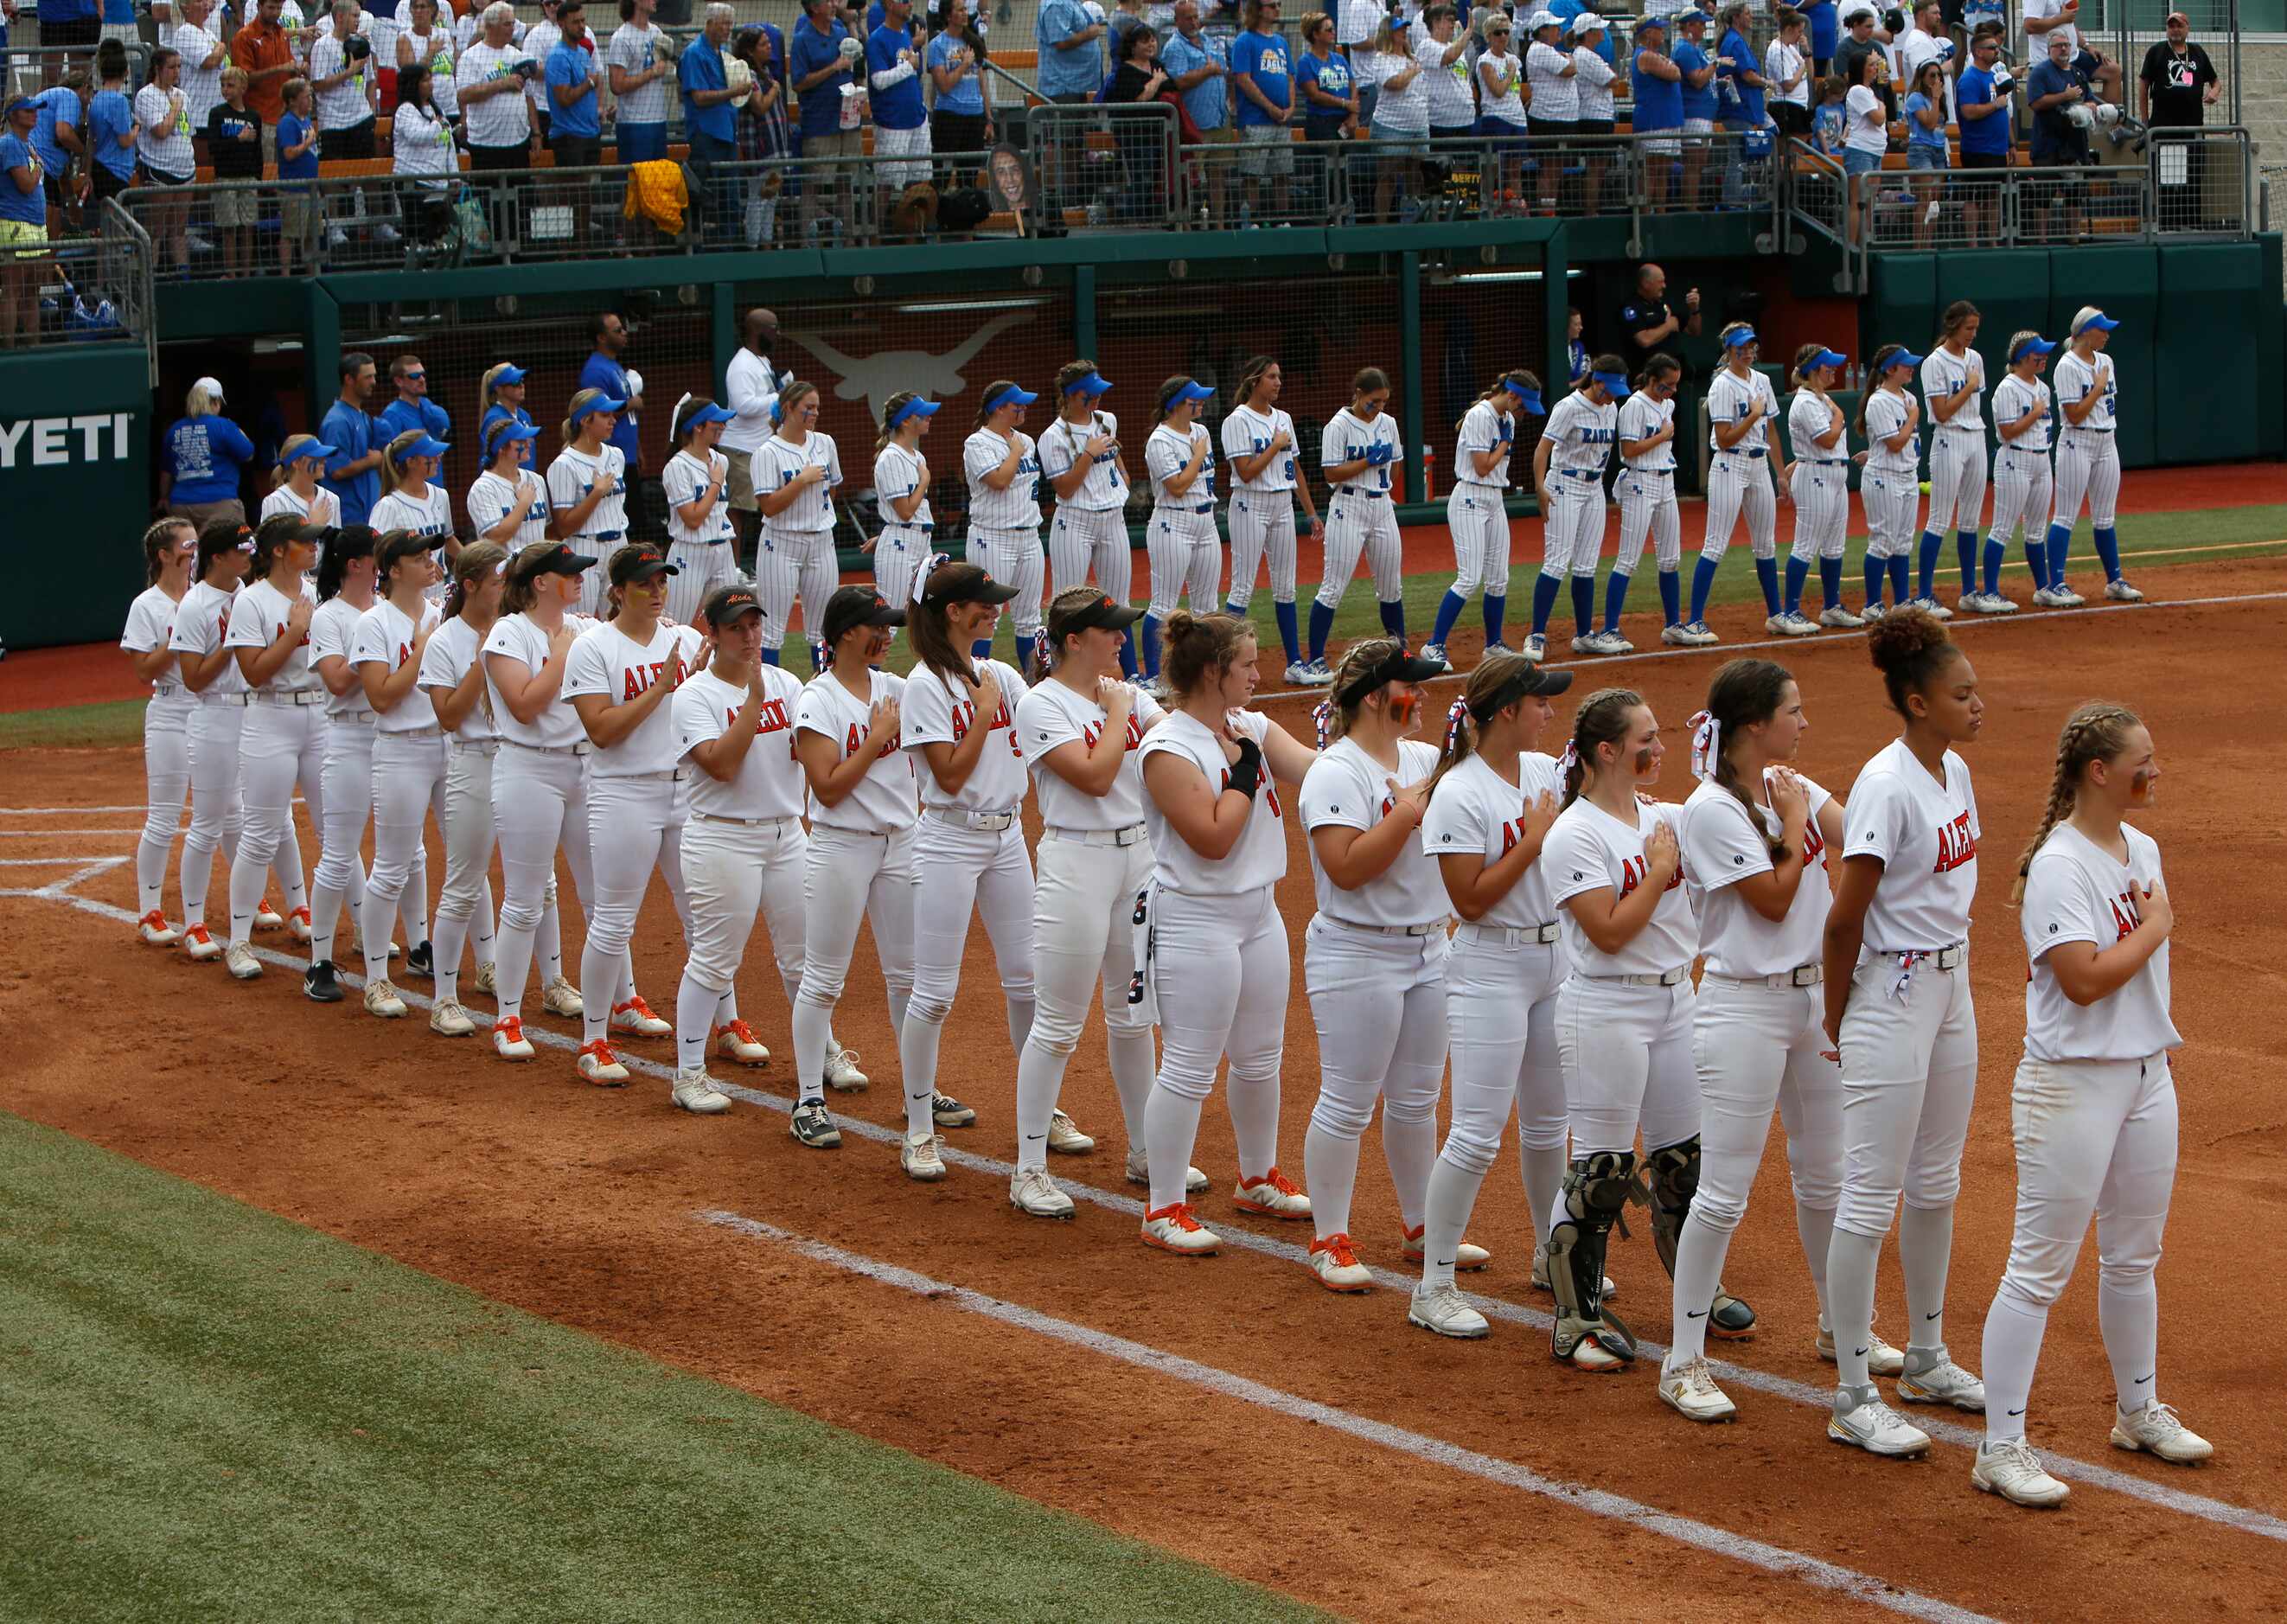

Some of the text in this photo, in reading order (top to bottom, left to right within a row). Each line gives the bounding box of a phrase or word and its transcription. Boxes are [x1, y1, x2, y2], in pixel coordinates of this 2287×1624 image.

[0, 412, 129, 468] YETI
[1285, 460, 1295, 481] 9
[1378, 469, 1389, 489] 1
